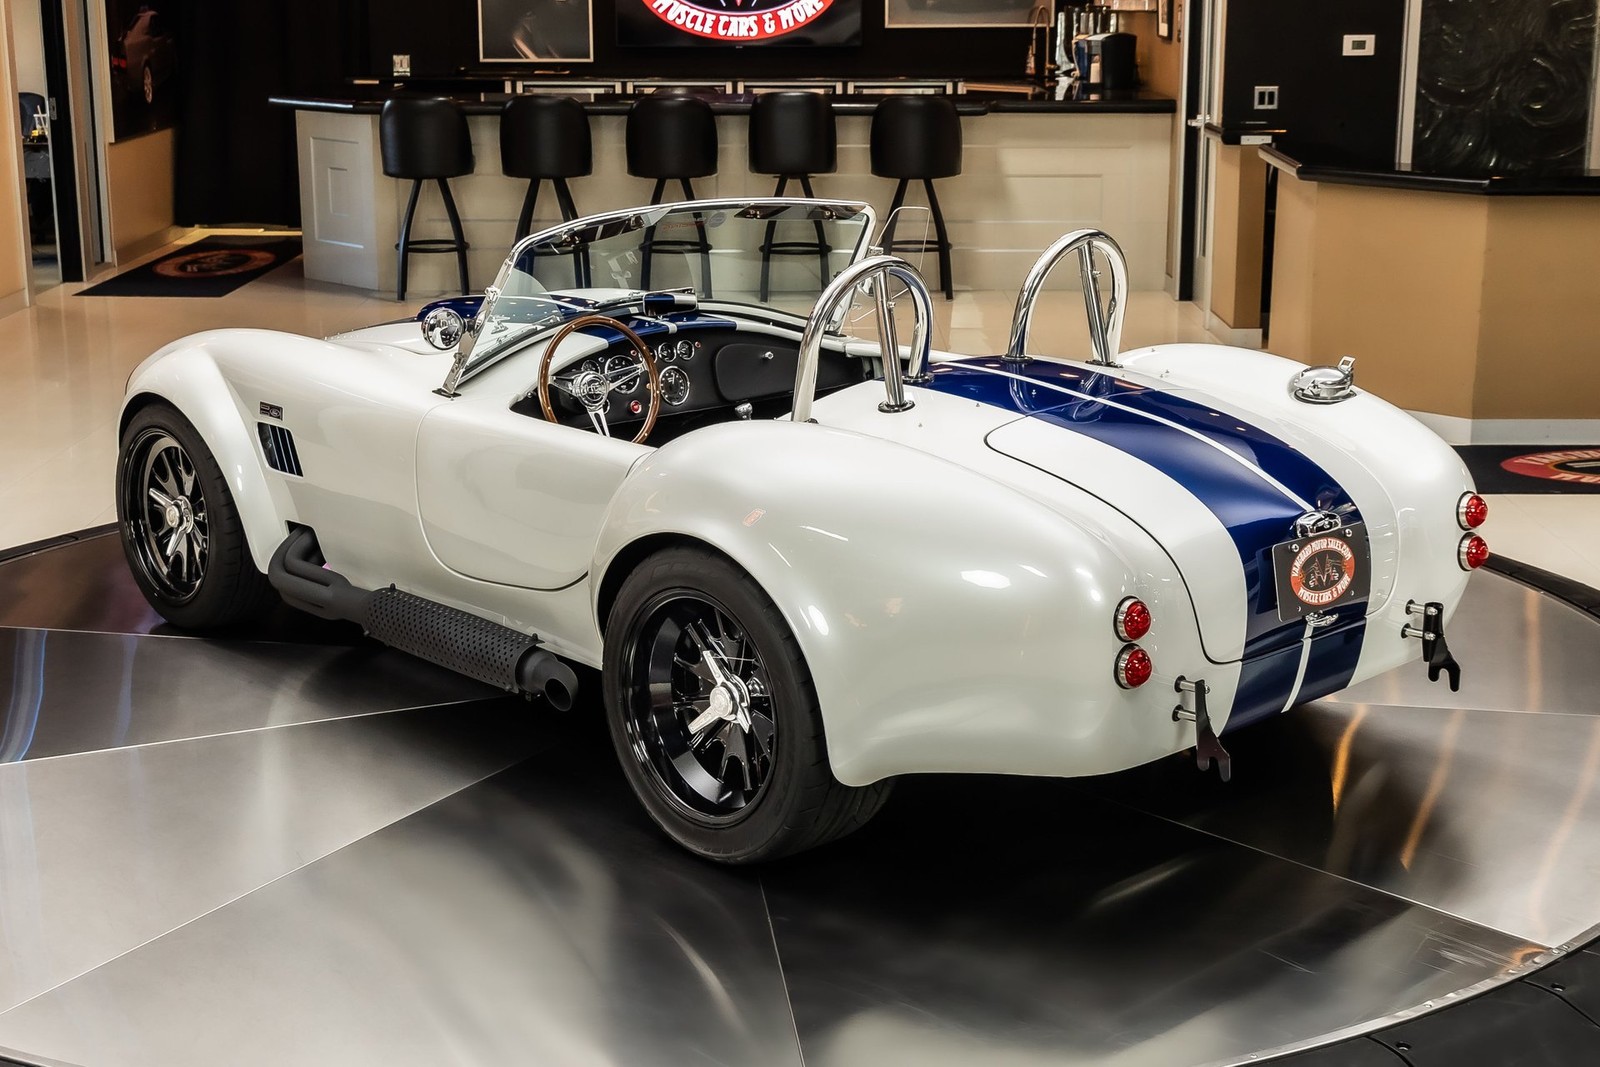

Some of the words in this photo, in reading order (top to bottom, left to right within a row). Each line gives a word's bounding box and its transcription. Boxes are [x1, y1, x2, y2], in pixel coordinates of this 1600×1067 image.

[652, 0, 716, 34] MUSCLE
[718, 15, 758, 37] CARS
[762, 12, 776, 34] &
[777, 0, 824, 30] MORE
[1298, 586, 1319, 603] MUSCLE
[1318, 591, 1333, 603] CARS
[1336, 573, 1351, 594] MORE
